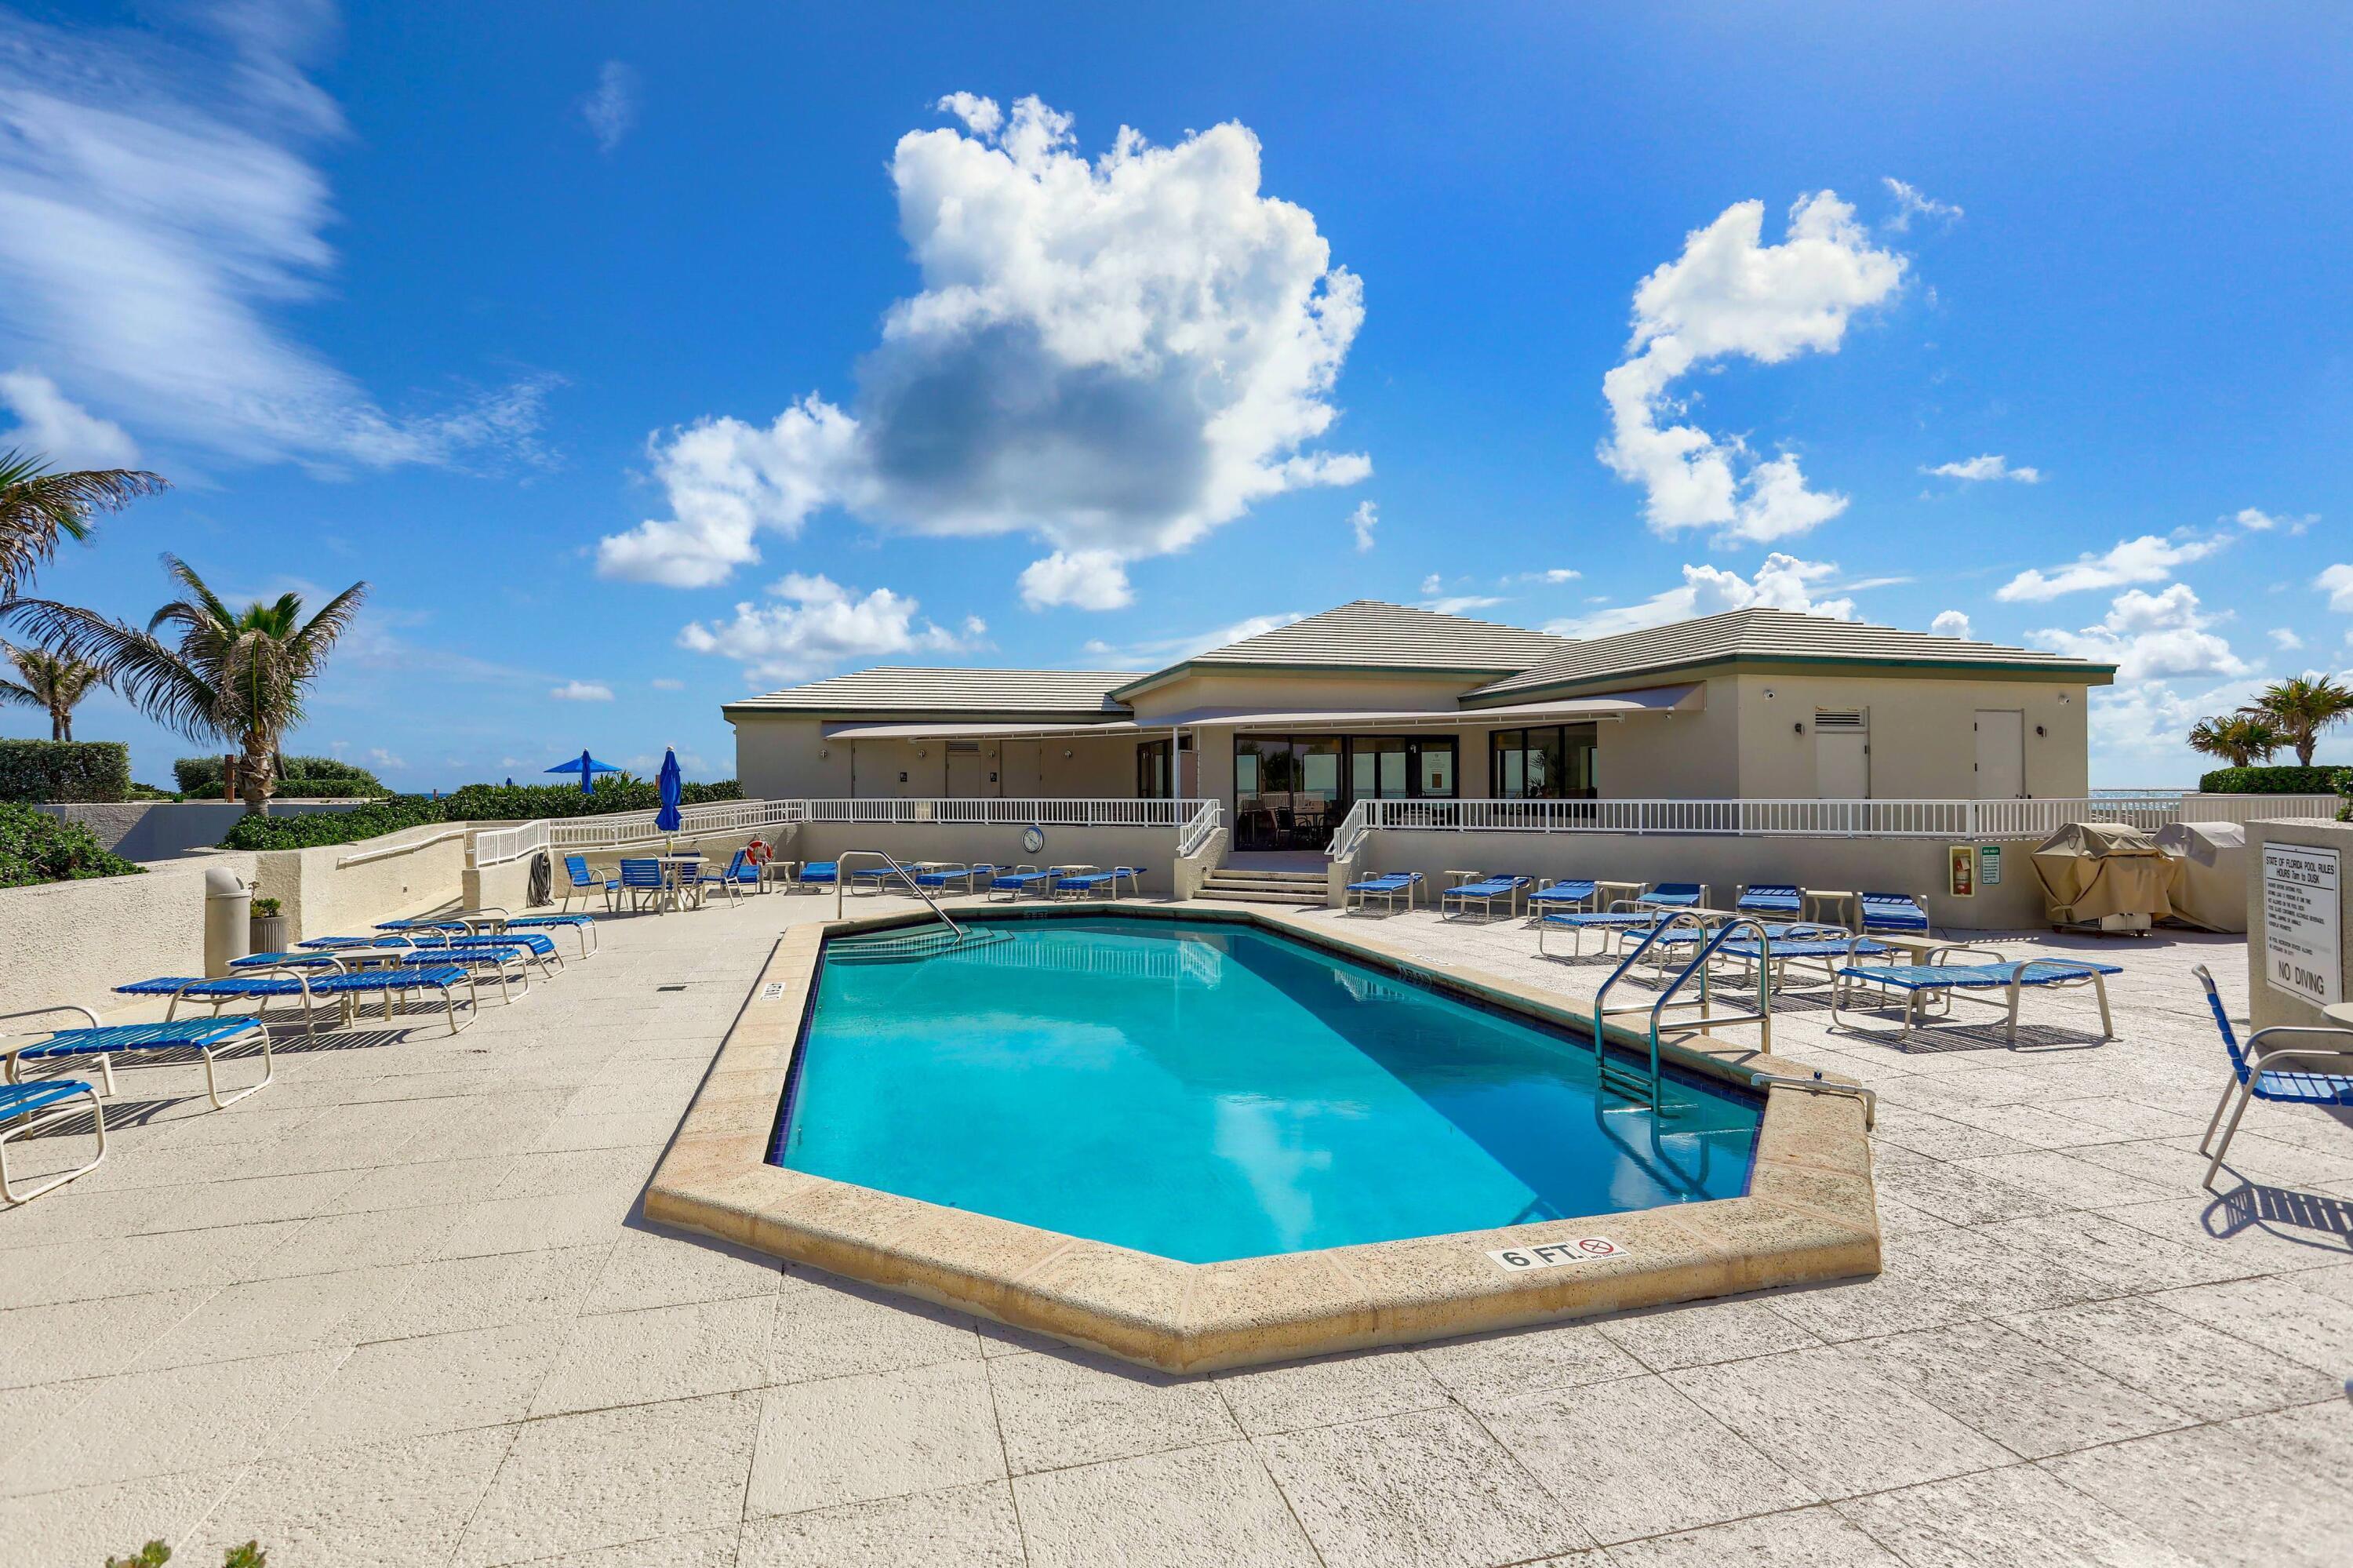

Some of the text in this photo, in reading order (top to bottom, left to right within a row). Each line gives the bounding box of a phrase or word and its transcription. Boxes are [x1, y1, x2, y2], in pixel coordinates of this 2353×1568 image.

[2266, 856, 2334, 875] STATE OF FLORIDA POOL RULES
[2276, 868, 2290, 879] HOURS
[2308, 873, 2319, 884] DUSK
[2278, 960, 2324, 995] NO DIVING
[1502, 1244, 1584, 1267] 6 FT.
